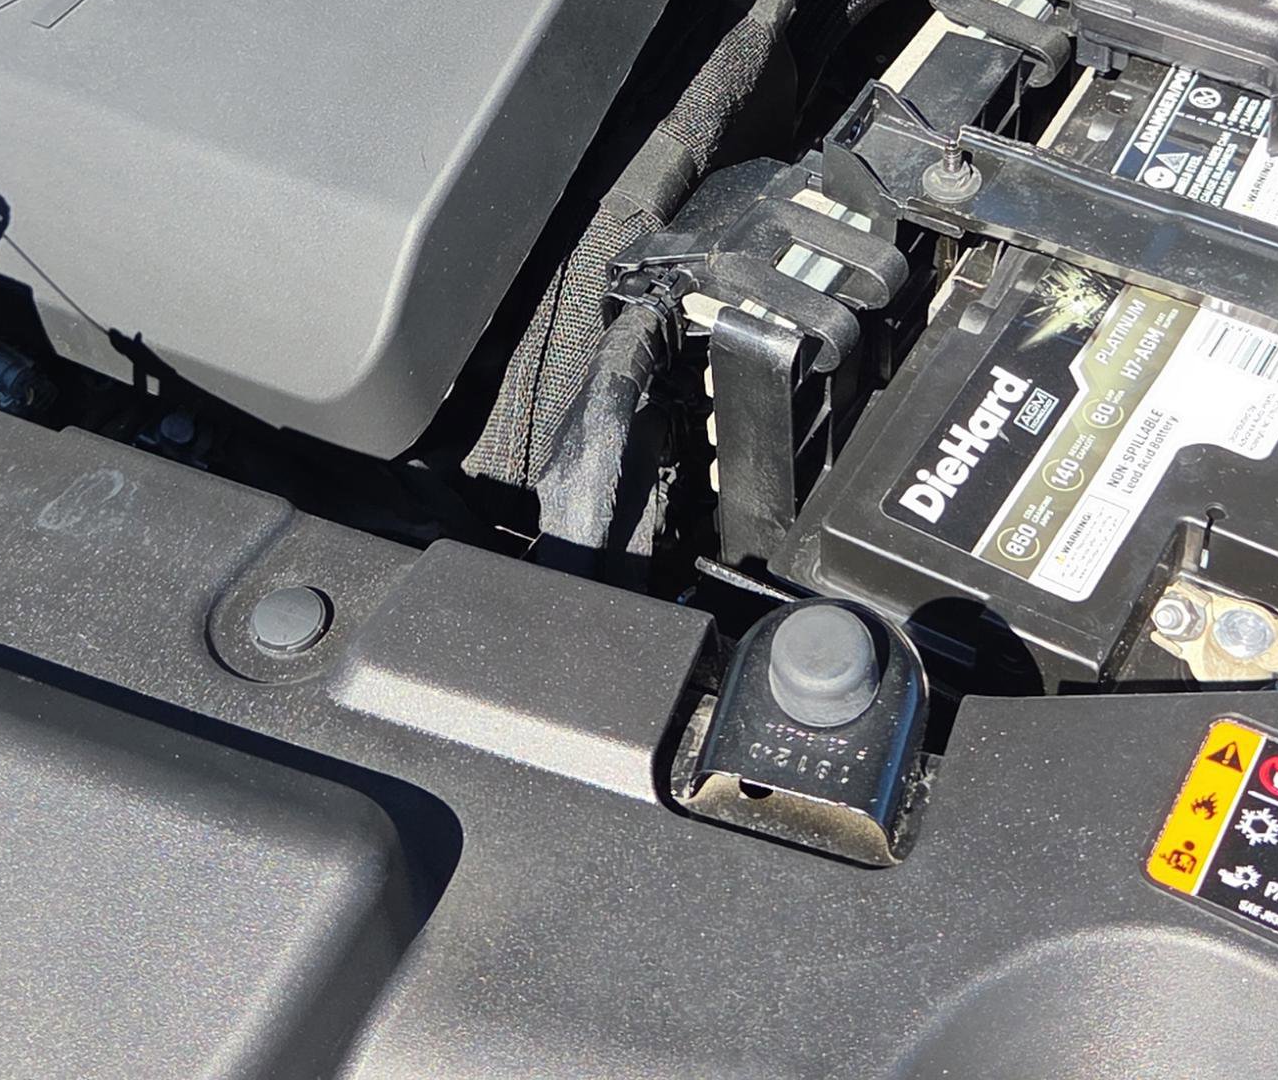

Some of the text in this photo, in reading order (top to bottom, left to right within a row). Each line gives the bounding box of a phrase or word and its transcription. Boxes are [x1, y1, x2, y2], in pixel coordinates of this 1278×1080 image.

[1094, 299, 1147, 365] PLATINUM
[1120, 329, 1165, 381] H7-AGM
[1021, 390, 1049, 428] AGM
[1091, 403, 1113, 425] 80
[899, 366, 1031, 524] DieHard
[1075, 435, 1097, 461] CAPACITY
[1107, 409, 1163, 489] NON-SPILLABLE
[1122, 415, 1180, 495] Lead Acid Battery
[1050, 459, 1078, 487] 140
[1005, 523, 1035, 556] 850
